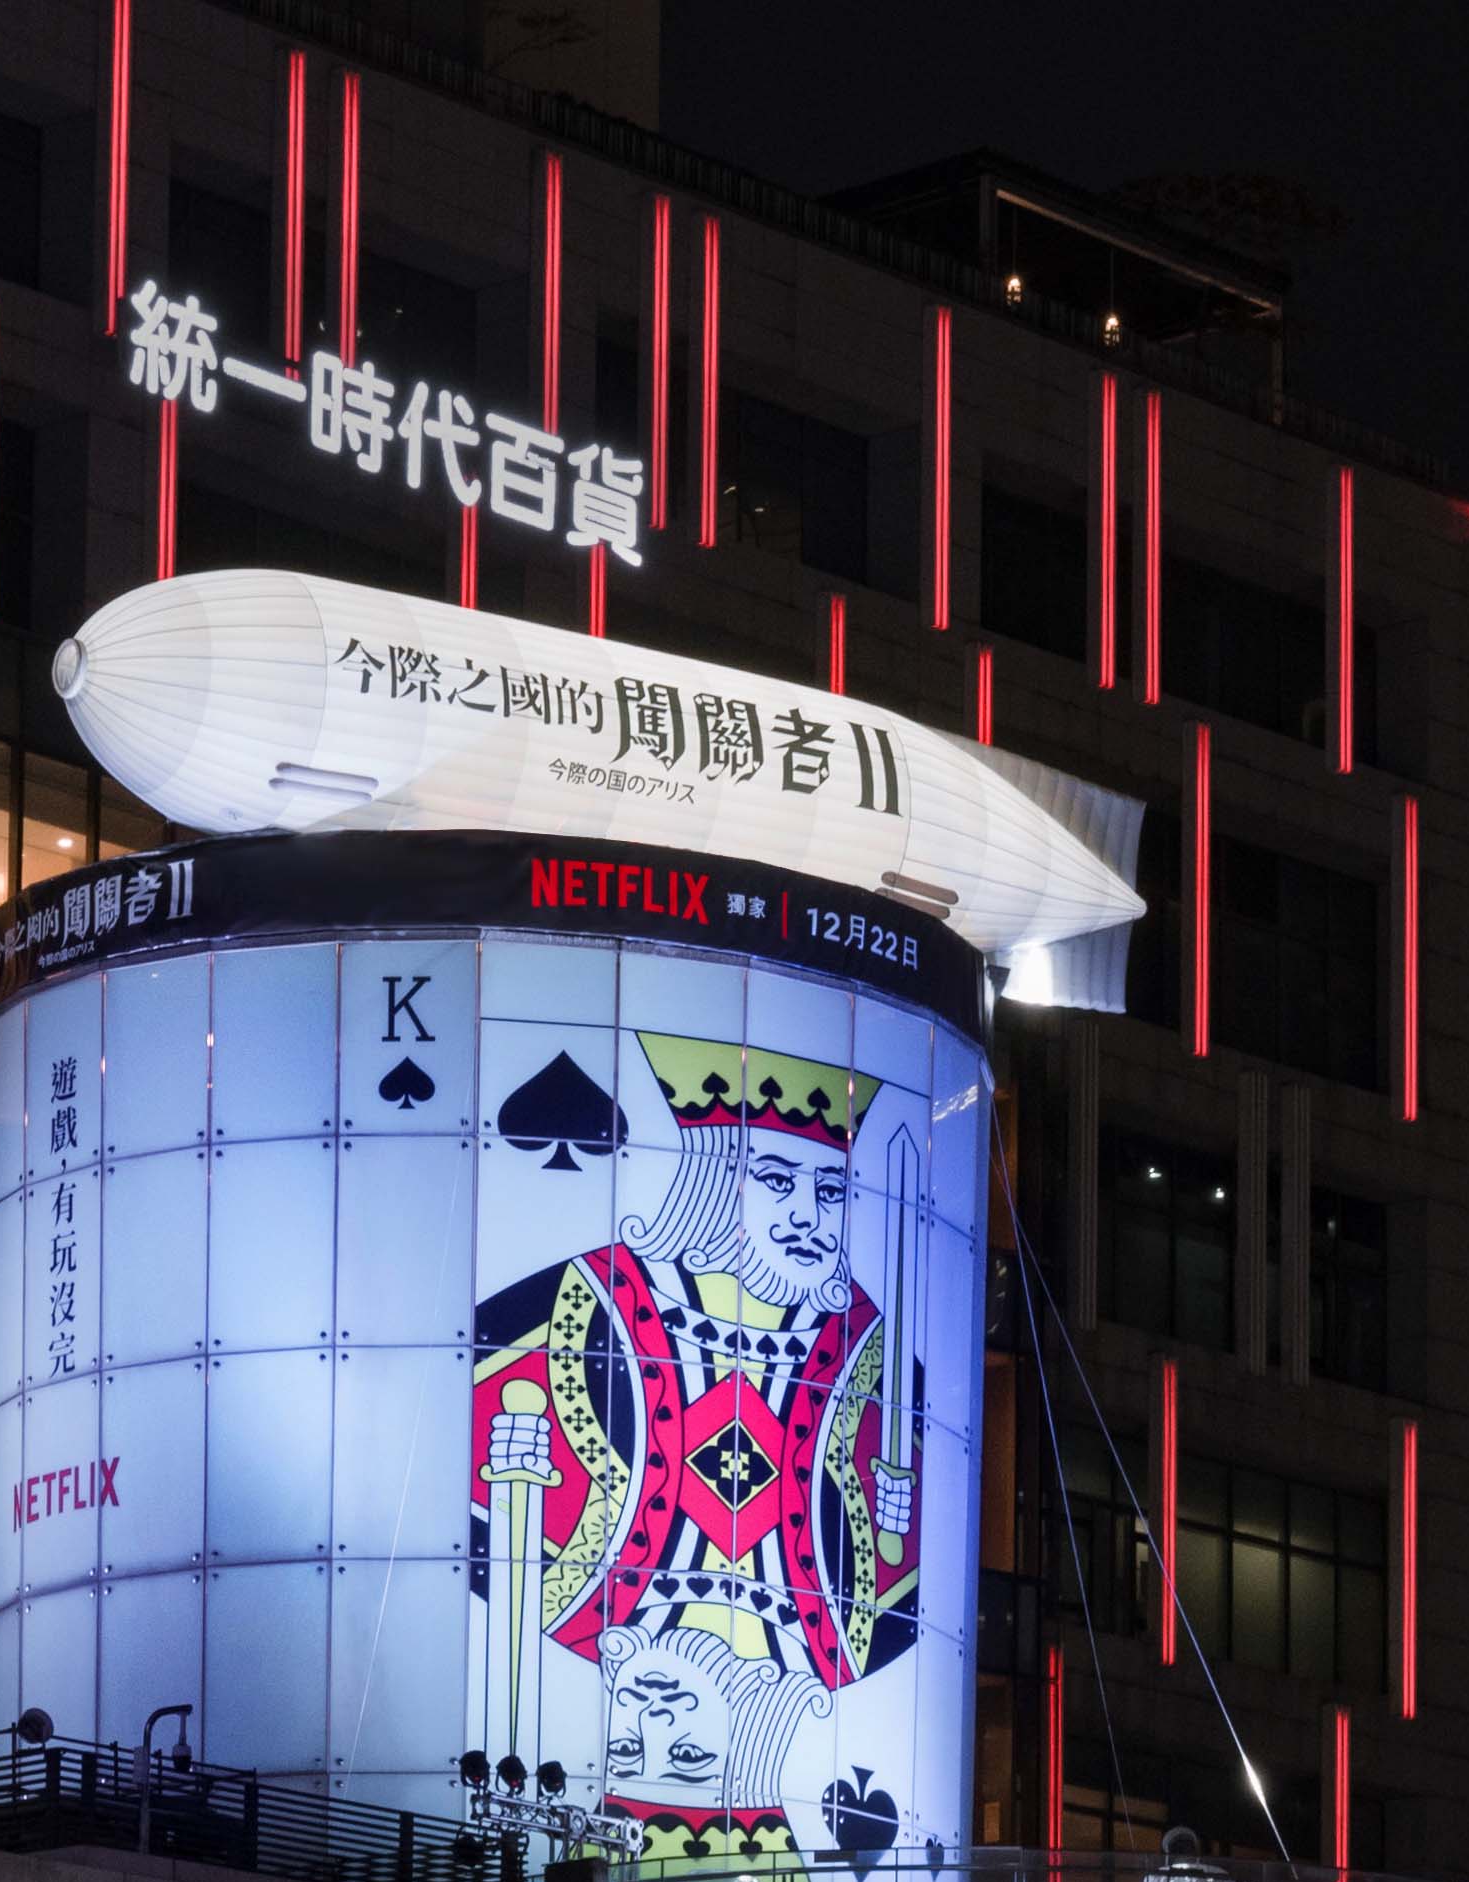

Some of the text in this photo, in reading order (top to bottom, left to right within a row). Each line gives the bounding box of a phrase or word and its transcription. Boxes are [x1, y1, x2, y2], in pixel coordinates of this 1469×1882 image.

[129, 279, 643, 568] 統一時代百貨
[547, 757, 697, 805] 今際の国のアリス
[531, 857, 711, 926] NETFLIX
[807, 906, 919, 972] 12月22日
[382, 976, 437, 1044] K
[12, 1456, 121, 1534] NETFLIX
